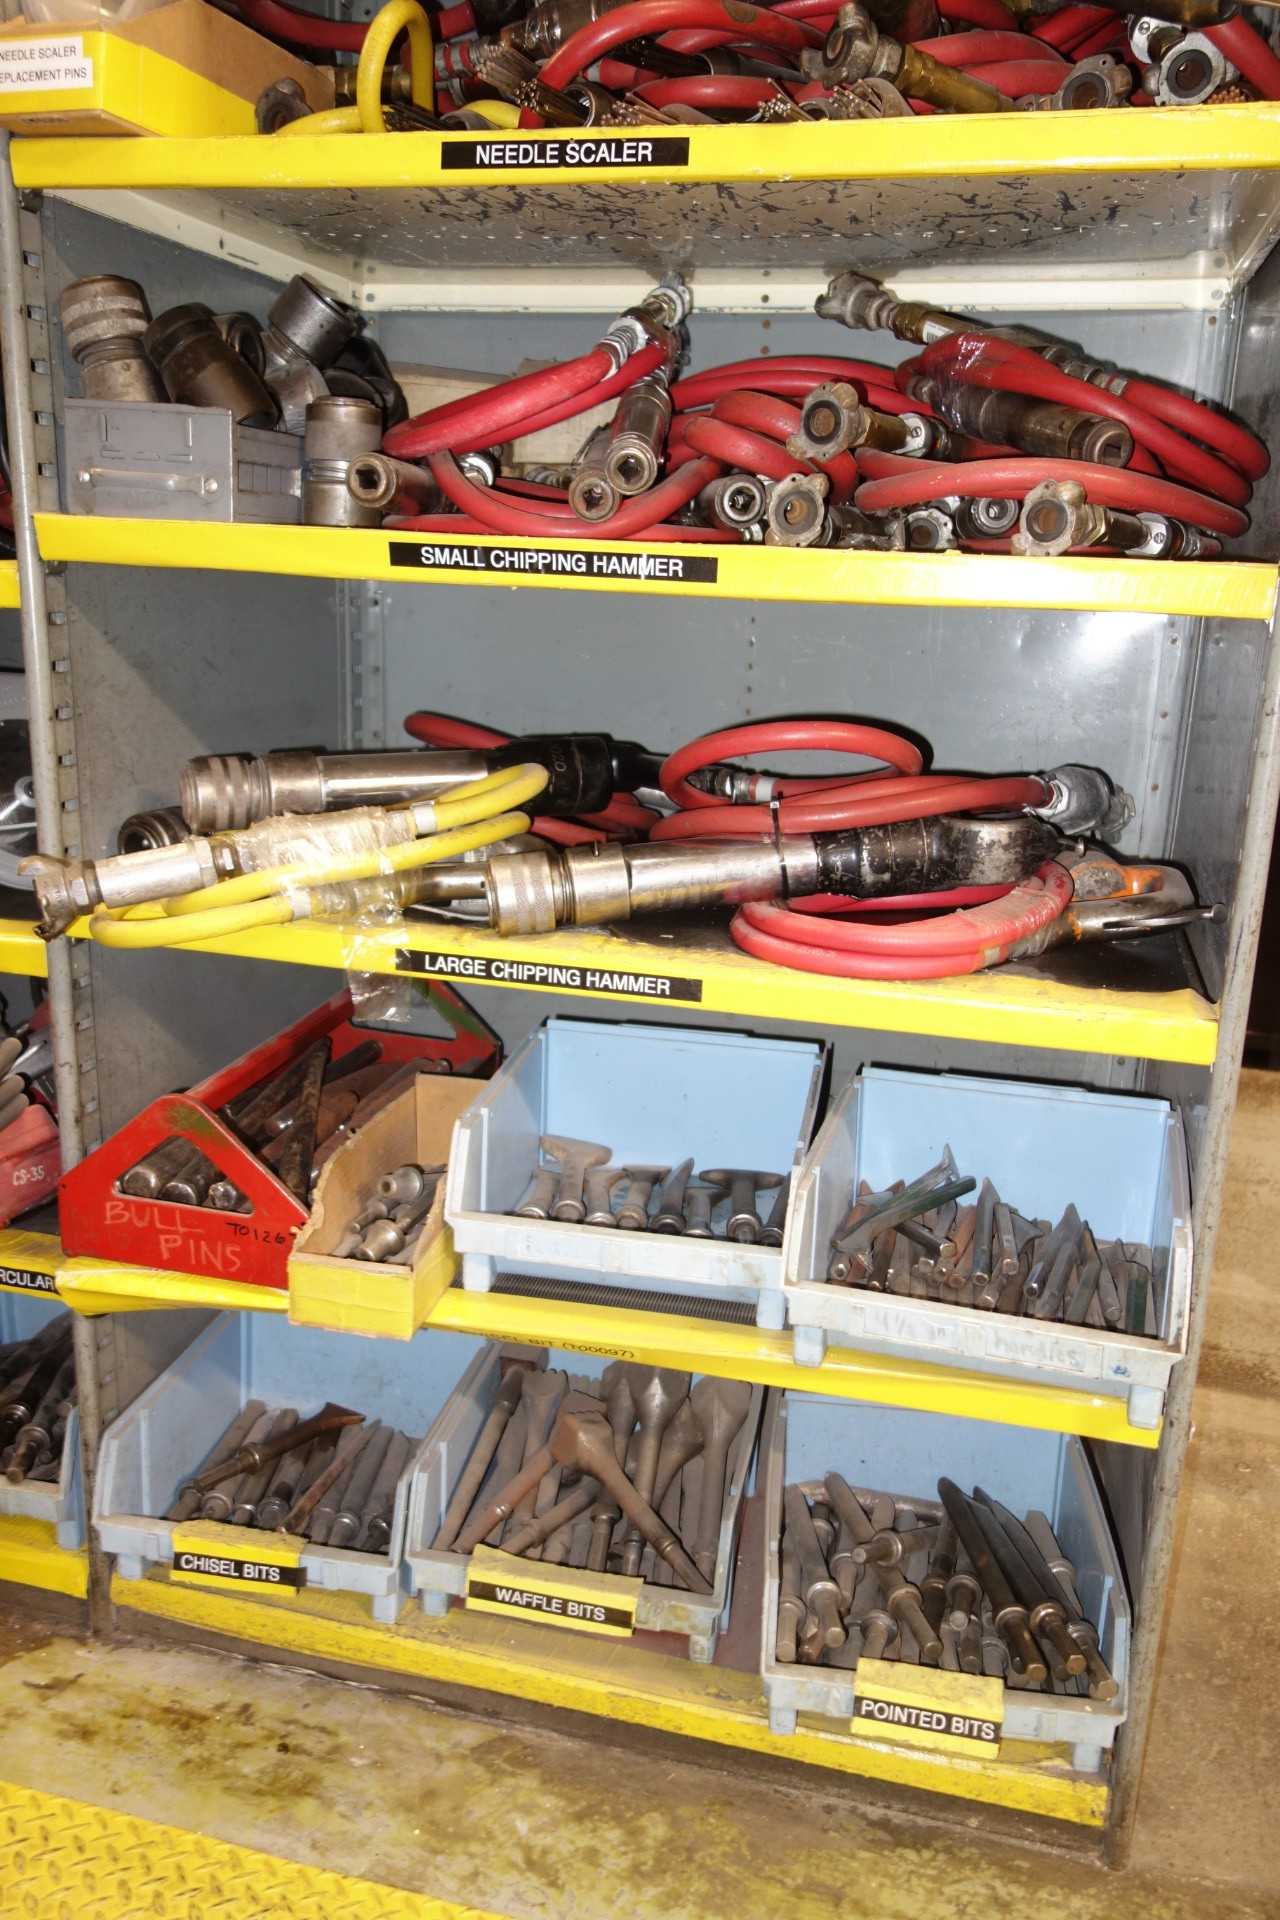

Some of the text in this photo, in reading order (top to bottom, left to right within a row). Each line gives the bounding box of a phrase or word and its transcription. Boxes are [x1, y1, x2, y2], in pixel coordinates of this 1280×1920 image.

[38, 46, 77, 59] SCALER
[64, 67, 87, 79] PINS
[475, 142, 653, 165] NEEDLE SCALER
[420, 546, 684, 578] SMALL CHIPPING HAMMER
[424, 955, 671, 996] LARGE CHIPPING HAMMER
[12, 1165, 45, 1186] CS-35
[104, 1201, 204, 1234] BULL
[158, 1234, 241, 1273] PINS
[180, 1554, 281, 1581] CHISEL BITS
[495, 1587, 606, 1622] WAFFLE BITS
[861, 1699, 996, 1740] POINTED BITS
